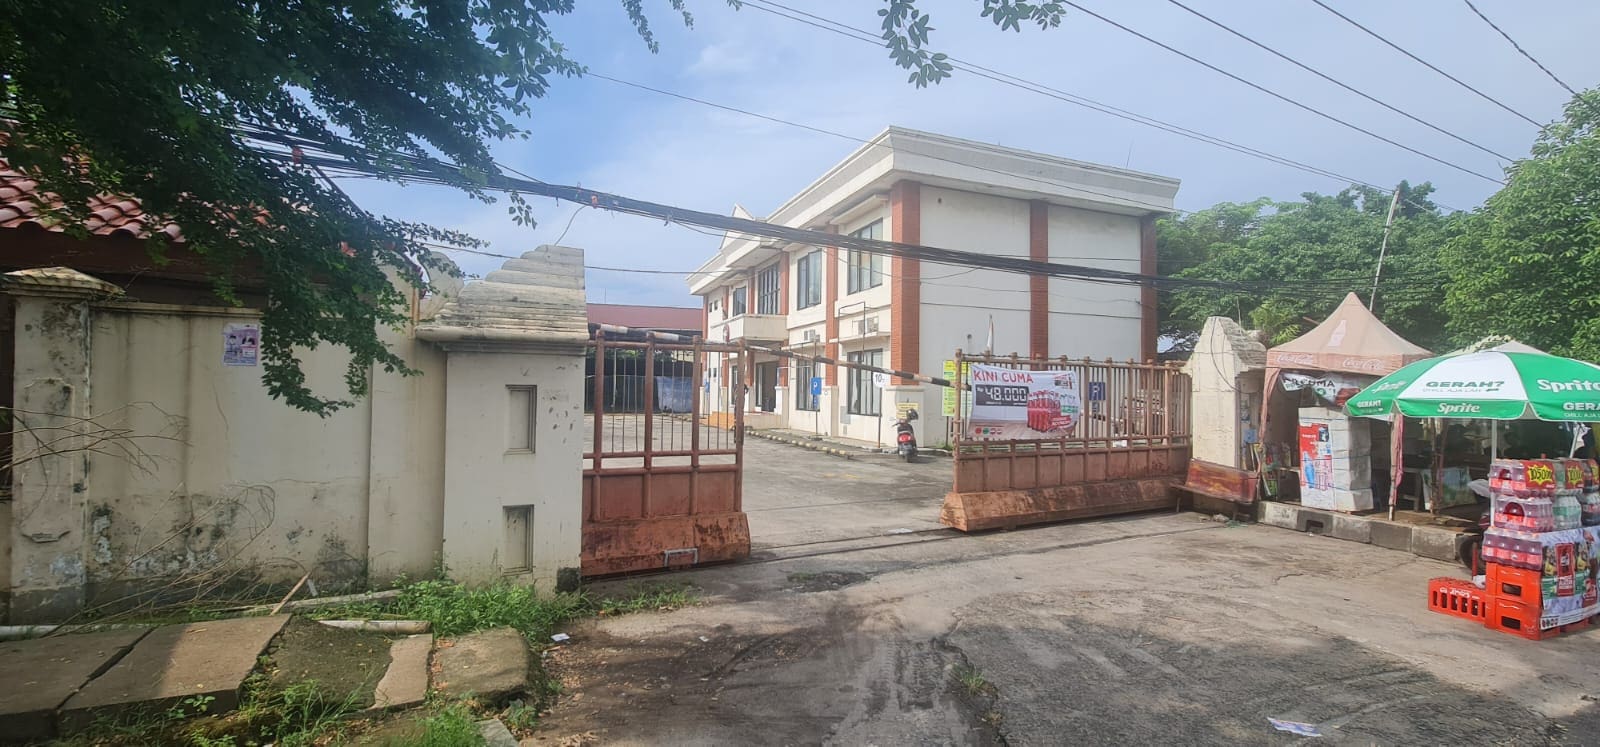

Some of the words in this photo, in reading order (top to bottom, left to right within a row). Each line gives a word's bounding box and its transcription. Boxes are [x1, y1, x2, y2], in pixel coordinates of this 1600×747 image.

[974, 370, 997, 381] KINI
[1001, 372, 1033, 383] CUMA
[985, 387, 1026, 401] 48.000
[1437, 402, 1481, 414] Sprite
